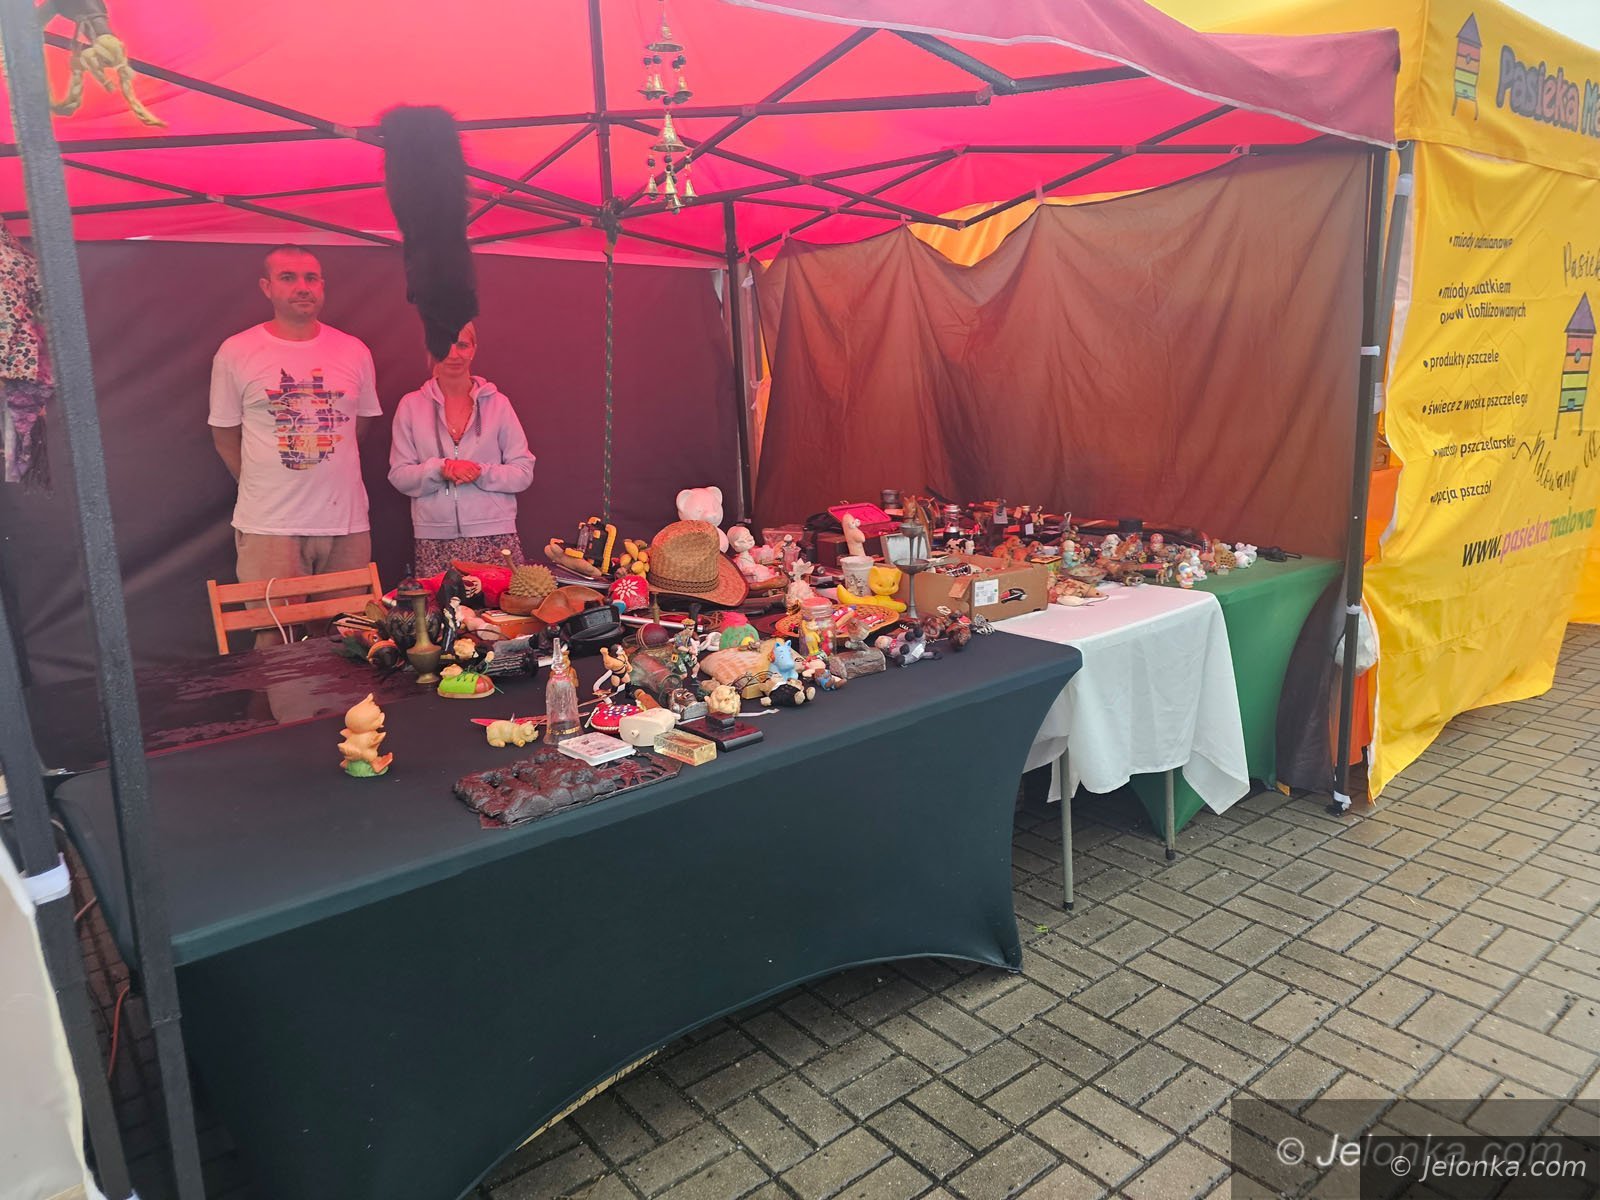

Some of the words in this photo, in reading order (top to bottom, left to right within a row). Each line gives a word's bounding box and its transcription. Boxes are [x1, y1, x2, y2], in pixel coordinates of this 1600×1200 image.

[1496, 45, 1579, 132] Pasieka
[1452, 232, 1475, 252] miody
[1442, 281, 1470, 301] miody
[1465, 301, 1526, 321] liofilizowanych
[1430, 351, 1466, 371] produkty
[1427, 399, 1455, 415] świece
[1455, 400, 1463, 411] z
[1460, 480, 1492, 501] pszczół
